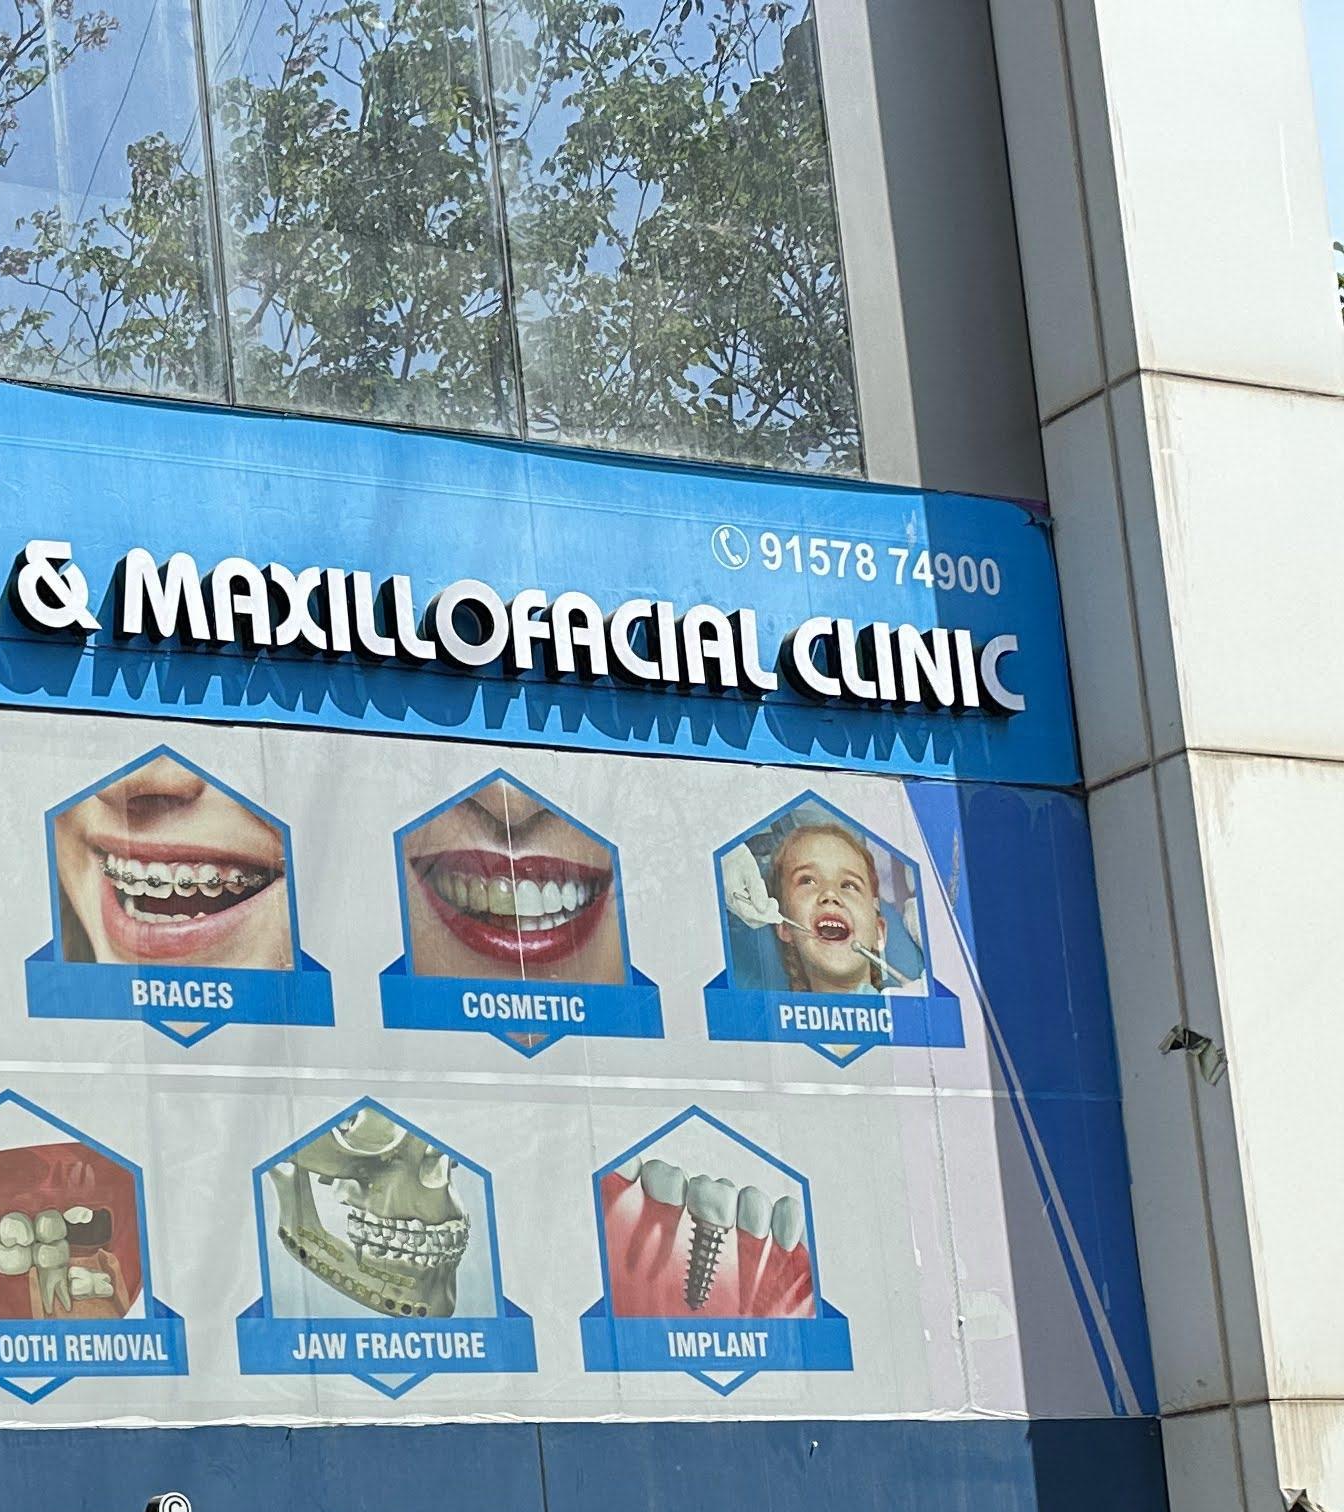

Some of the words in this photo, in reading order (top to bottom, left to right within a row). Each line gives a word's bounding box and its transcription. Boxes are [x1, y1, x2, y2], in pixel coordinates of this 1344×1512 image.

[758, 531, 876, 583] 91578
[887, 545, 1002, 596] 74900
[14, 540, 104, 632] &
[121, 546, 774, 692] MAXILLOFACIAL
[794, 615, 1026, 712] CLINIC
[131, 978, 234, 1010] BRACES
[462, 991, 586, 1023] COSMETIC
[779, 1004, 894, 1034] PEDIATRIC
[64, 1332, 169, 1362] REMOVAL
[291, 1331, 349, 1360] JAW
[356, 1331, 487, 1360] FRACTURE
[667, 1331, 769, 1358] IMPLANT
